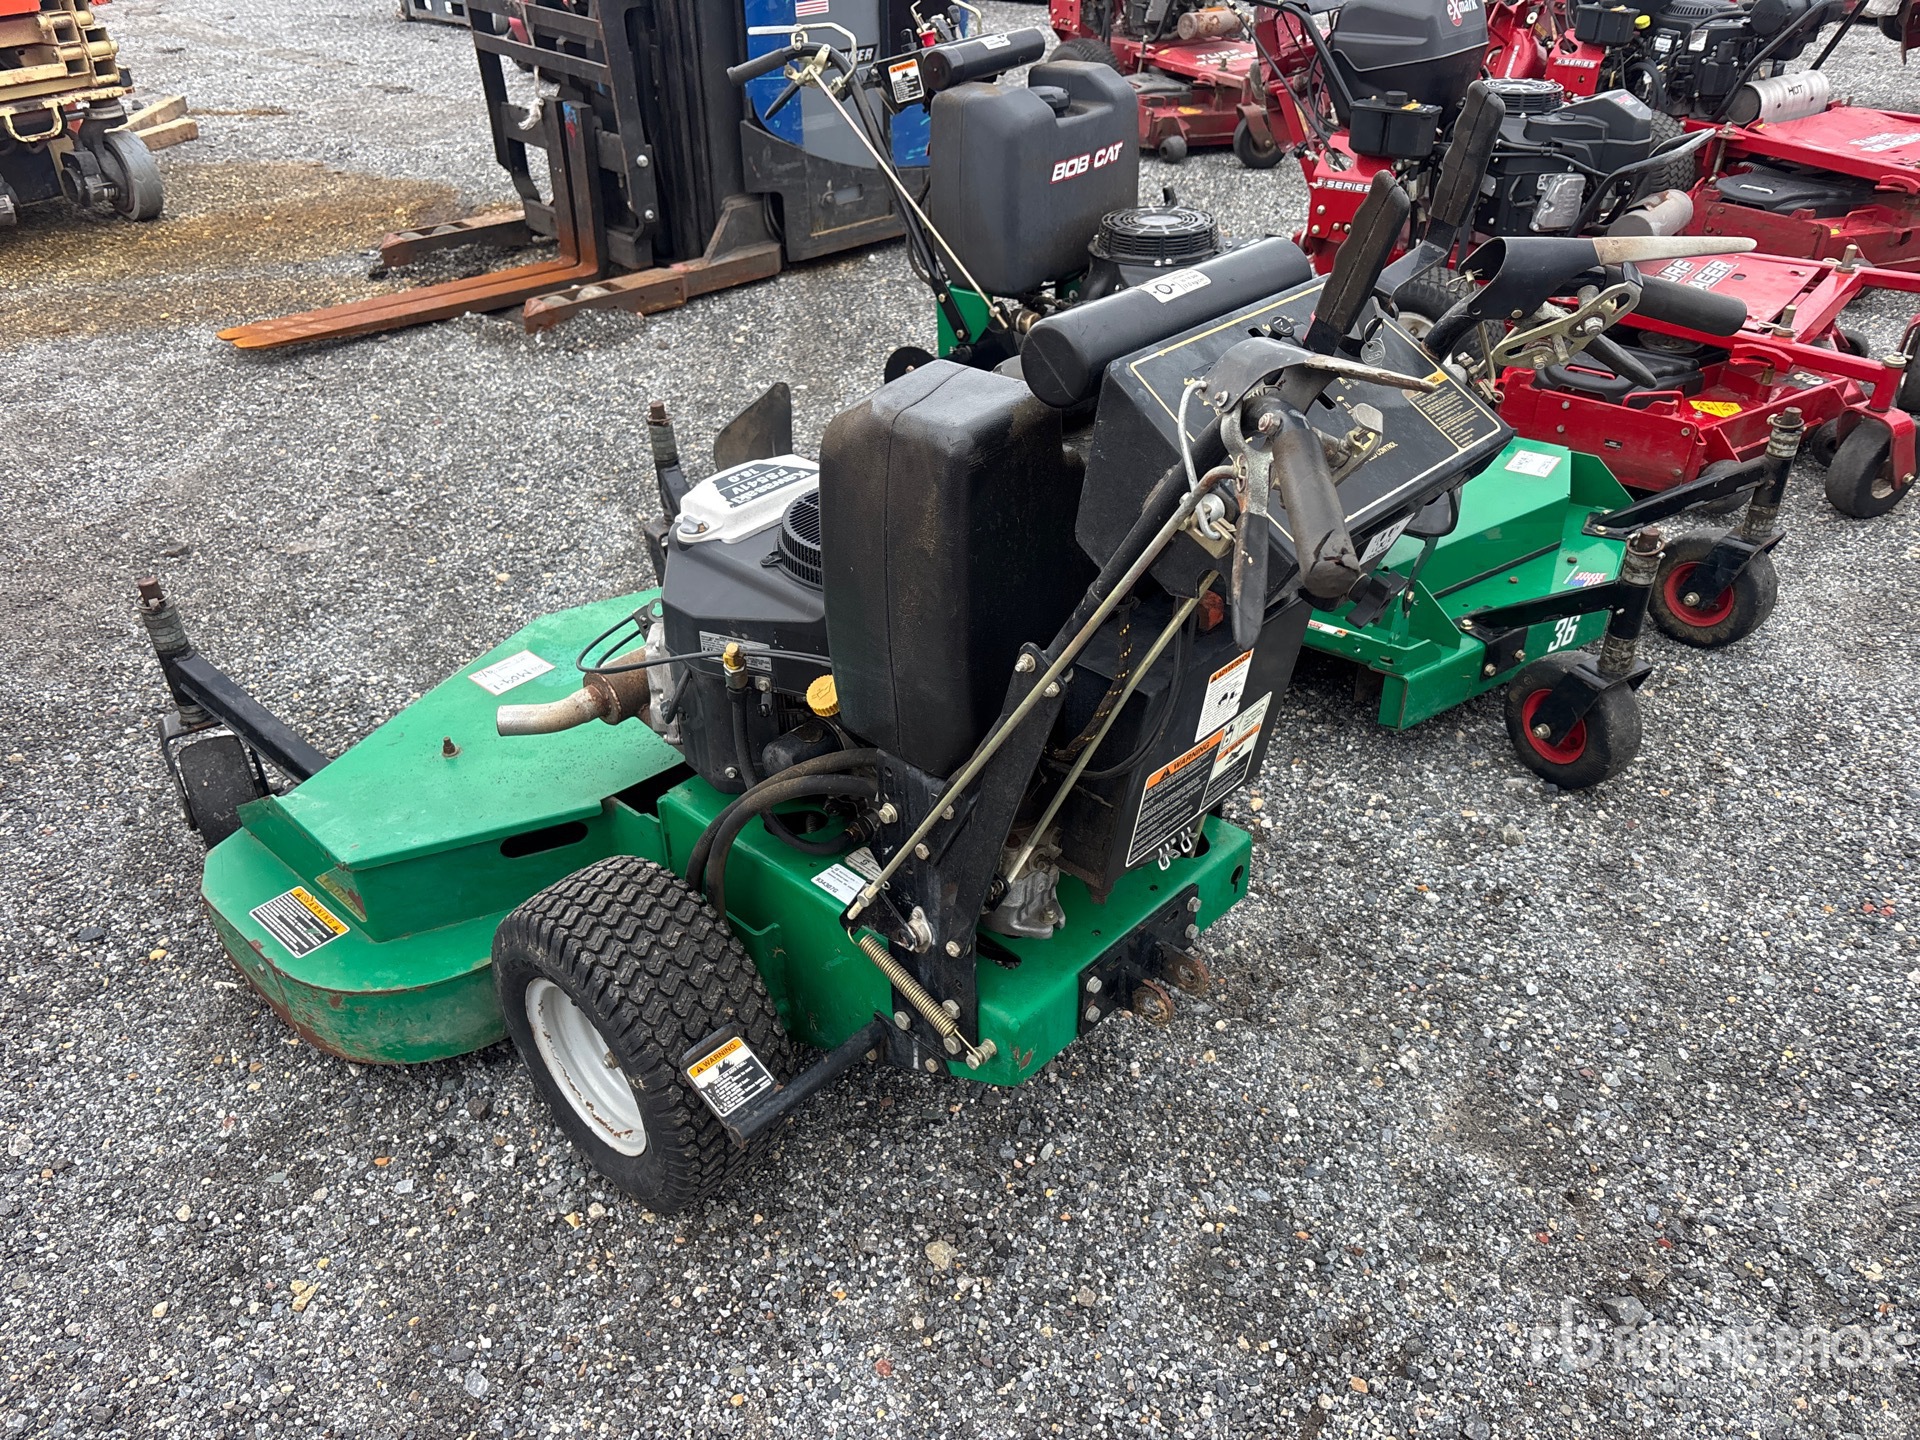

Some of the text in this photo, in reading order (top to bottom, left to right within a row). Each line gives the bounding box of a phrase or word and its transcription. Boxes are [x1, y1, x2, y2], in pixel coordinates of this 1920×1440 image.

[1788, 83, 1804, 96] HOT
[1654, 258, 1694, 284] URF
[1684, 260, 1736, 290] ACER
[727, 468, 760, 483] 18.0
[729, 469, 812, 505] Kawasaki
[731, 468, 789, 496] FS541V
[1547, 614, 1582, 653] 36
[1172, 741, 1211, 771] WARNING
[702, 1042, 738, 1068] WARNING
